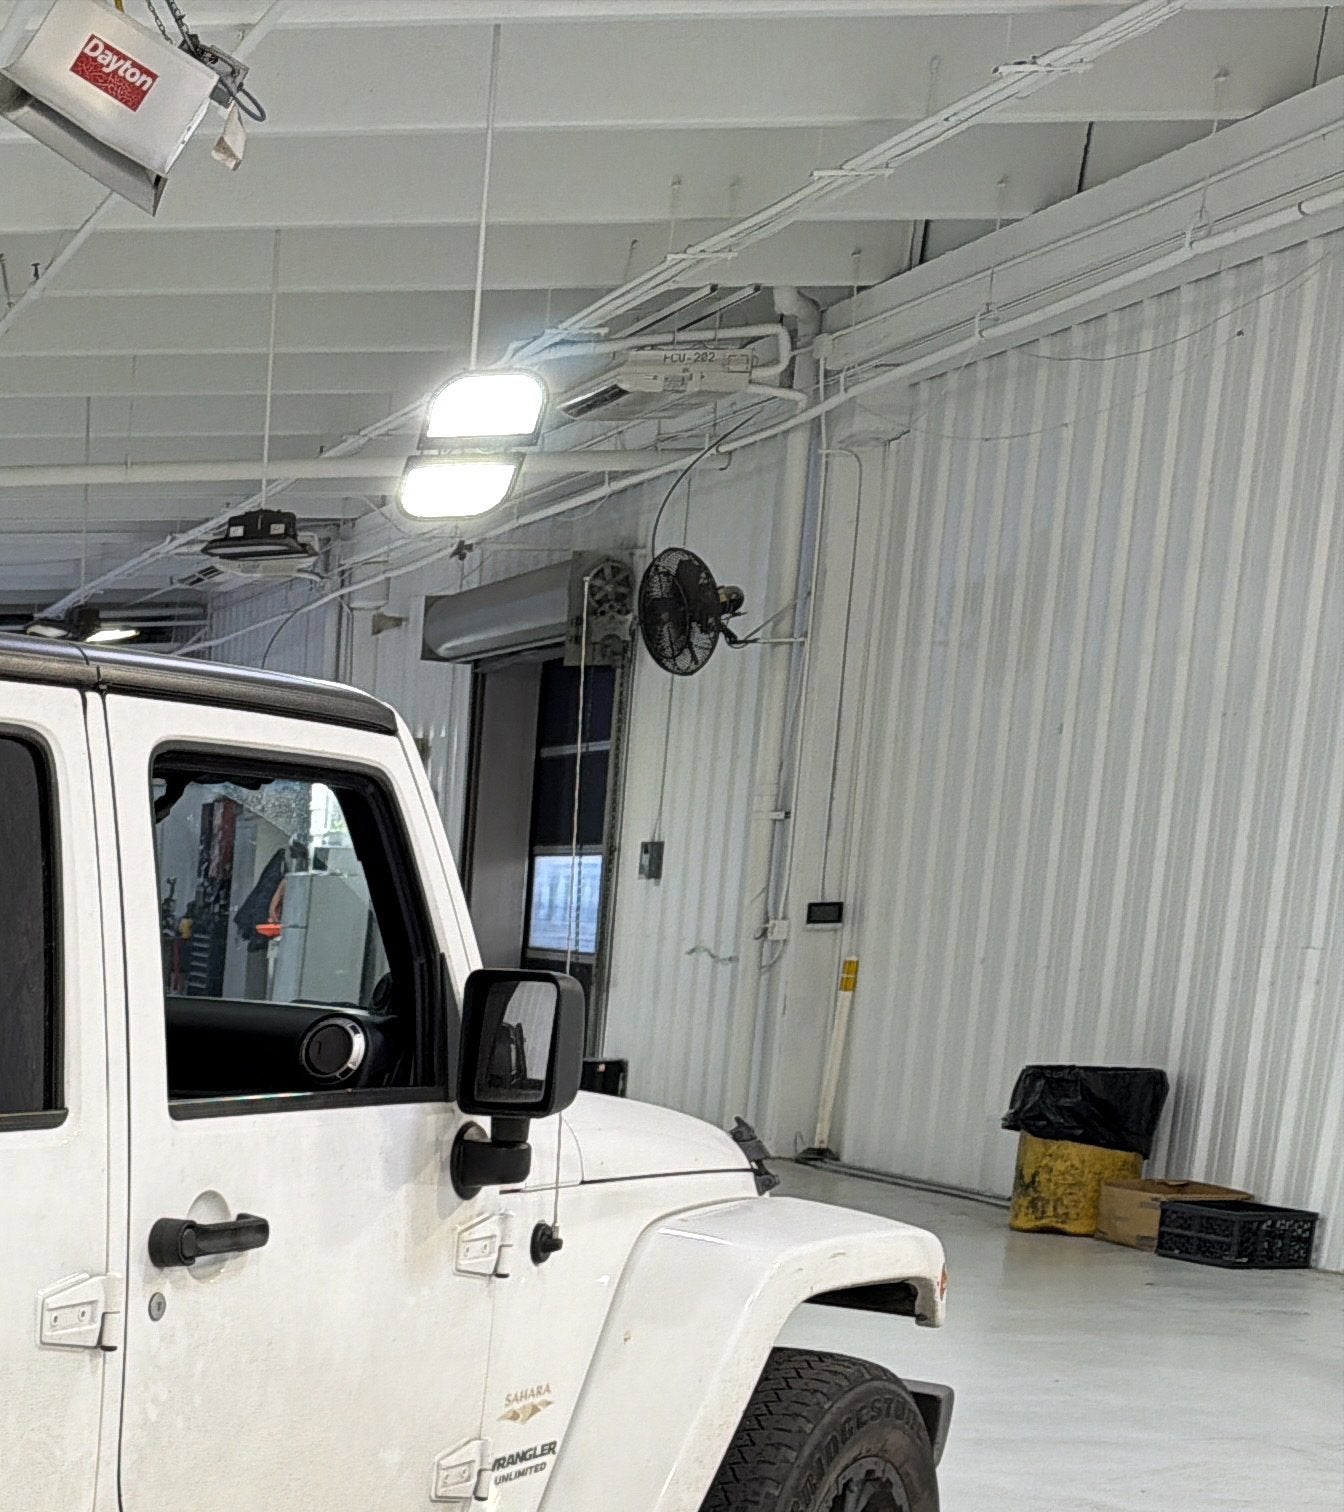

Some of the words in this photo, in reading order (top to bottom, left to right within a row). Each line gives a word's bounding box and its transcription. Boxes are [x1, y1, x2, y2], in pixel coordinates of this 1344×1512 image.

[83, 37, 153, 91] Dayton
[663, 351, 716, 364] FCU-202
[504, 1383, 552, 1407] SAHARA
[494, 1462, 547, 1486] UNLIMITED
